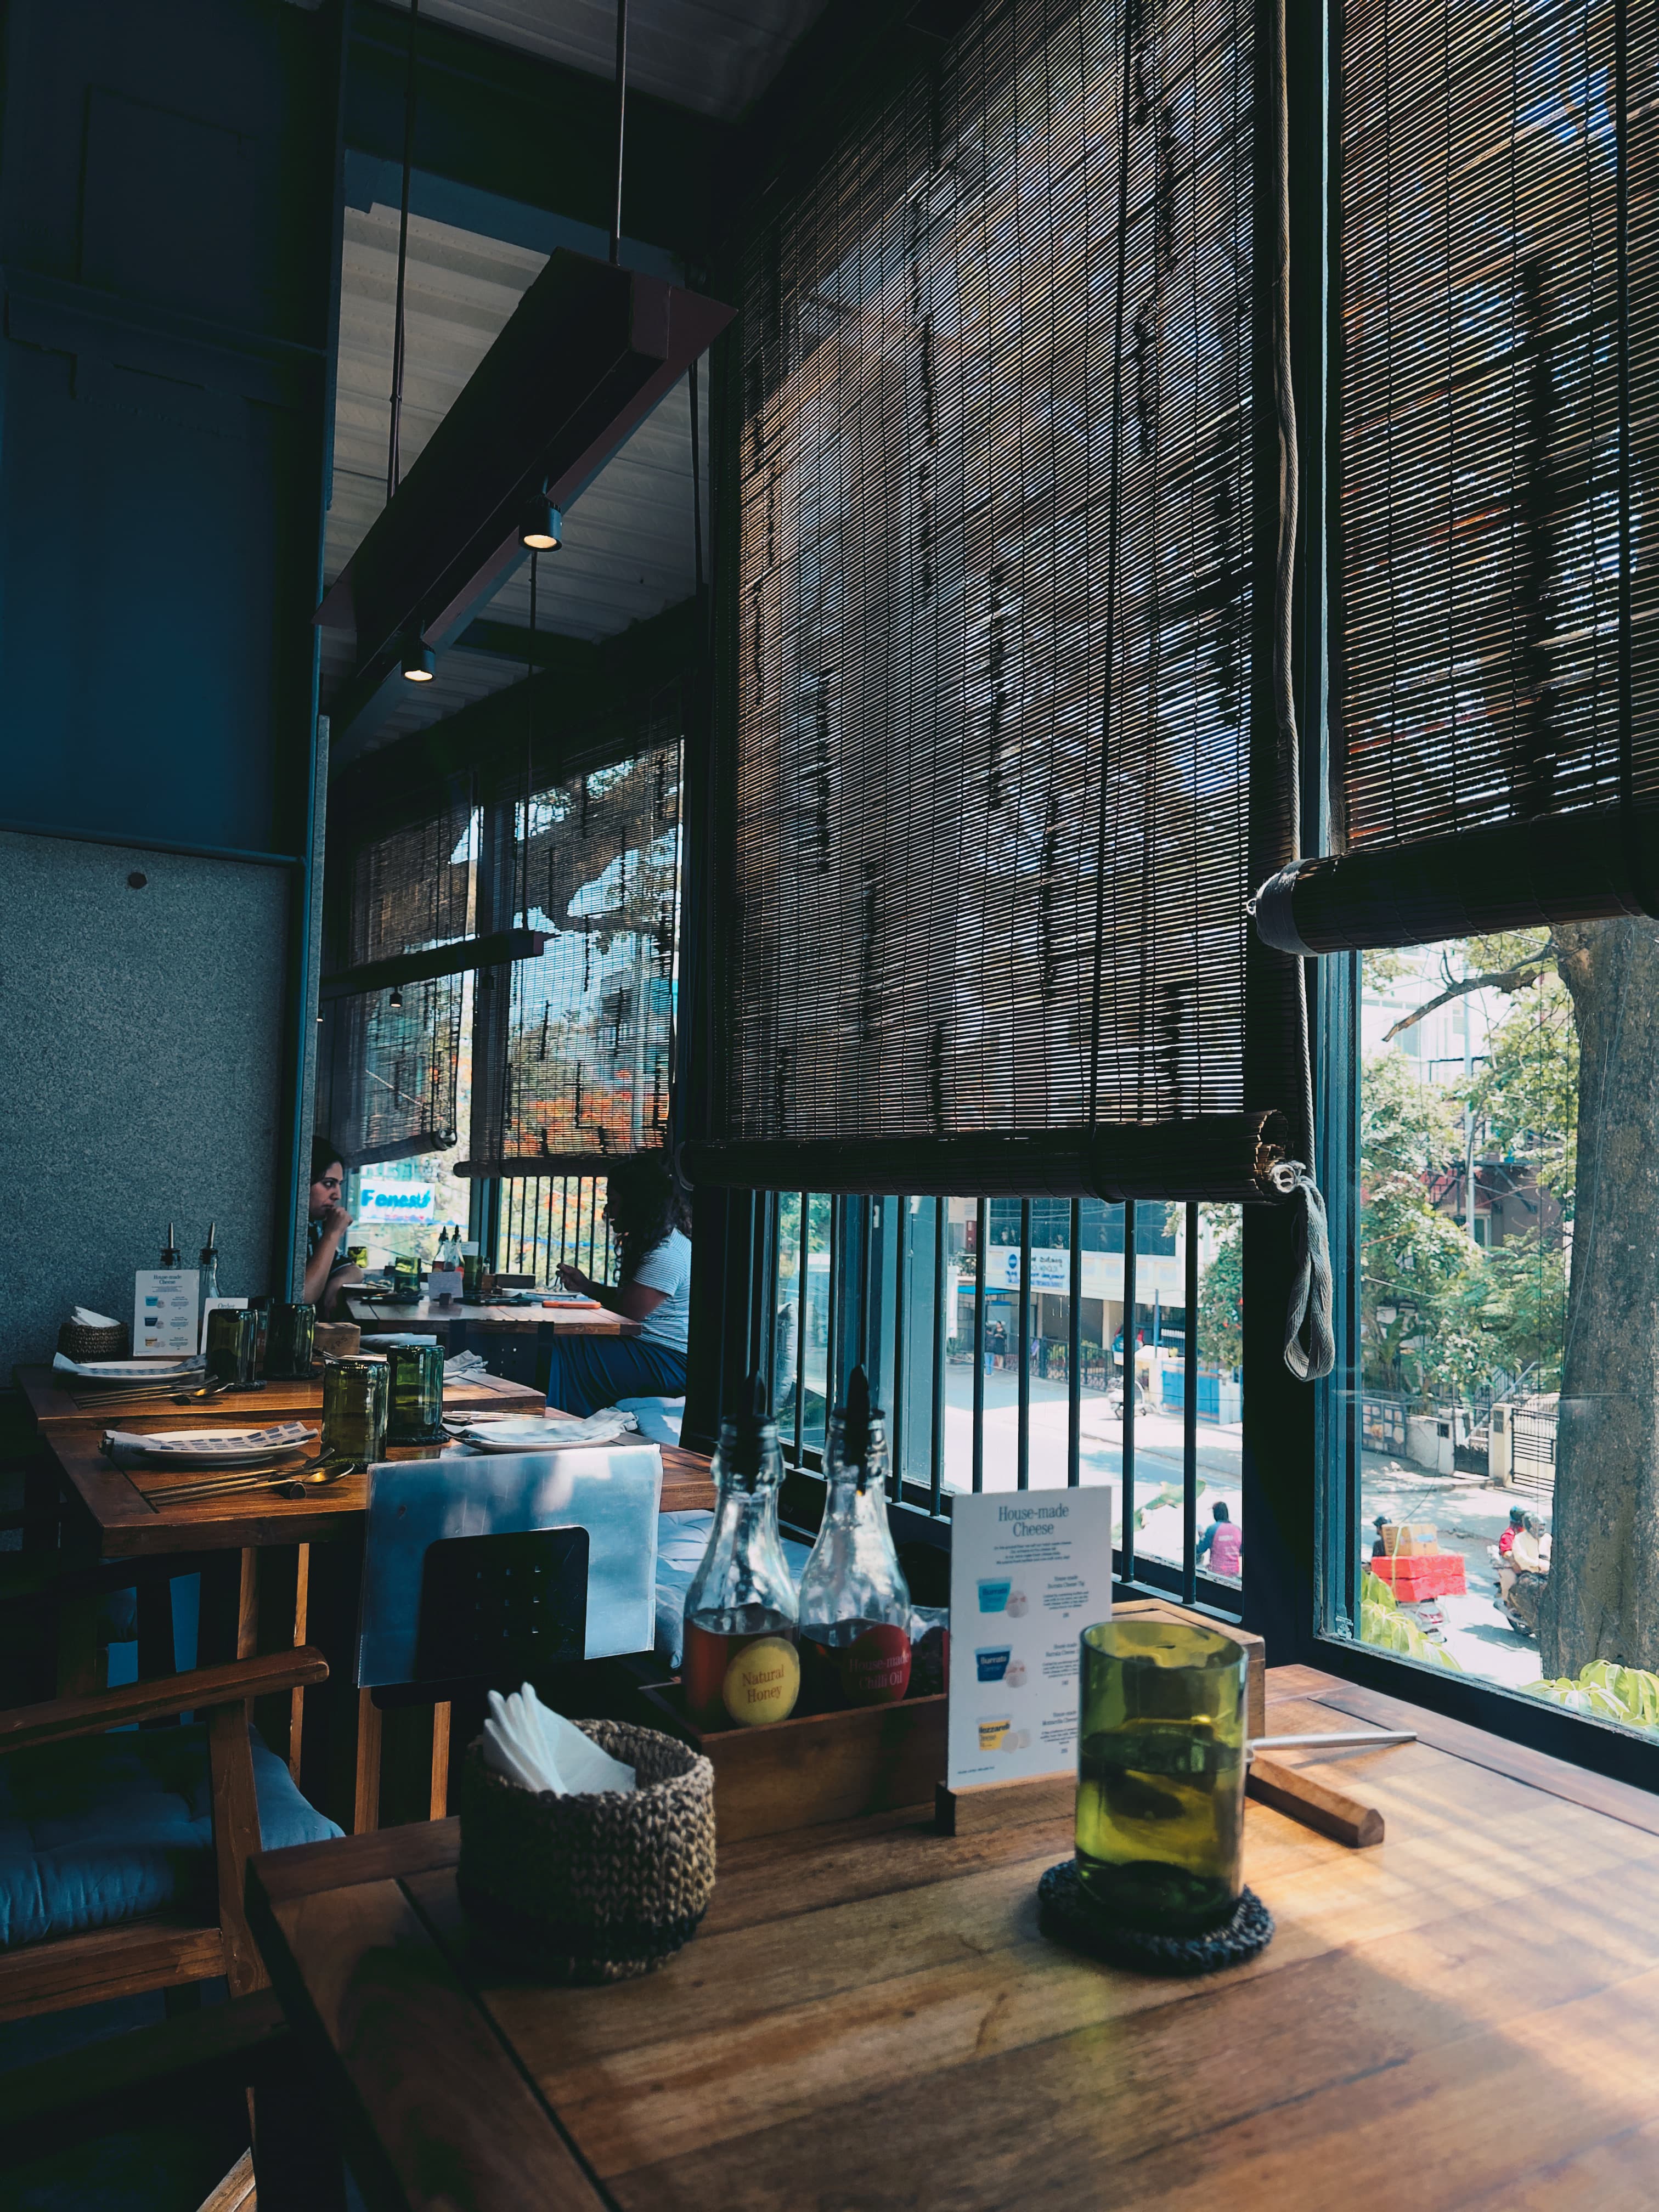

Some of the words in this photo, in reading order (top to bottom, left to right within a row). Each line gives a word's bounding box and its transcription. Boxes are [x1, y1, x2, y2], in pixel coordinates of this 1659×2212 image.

[998, 1503, 1069, 1522] House-made
[1013, 1522, 1054, 1537] Cheese
[849, 1653, 909, 1673] House-made
[742, 1664, 784, 1686] Natural
[890, 1671, 902, 1686] Oil
[748, 1686, 782, 1703] Honey
